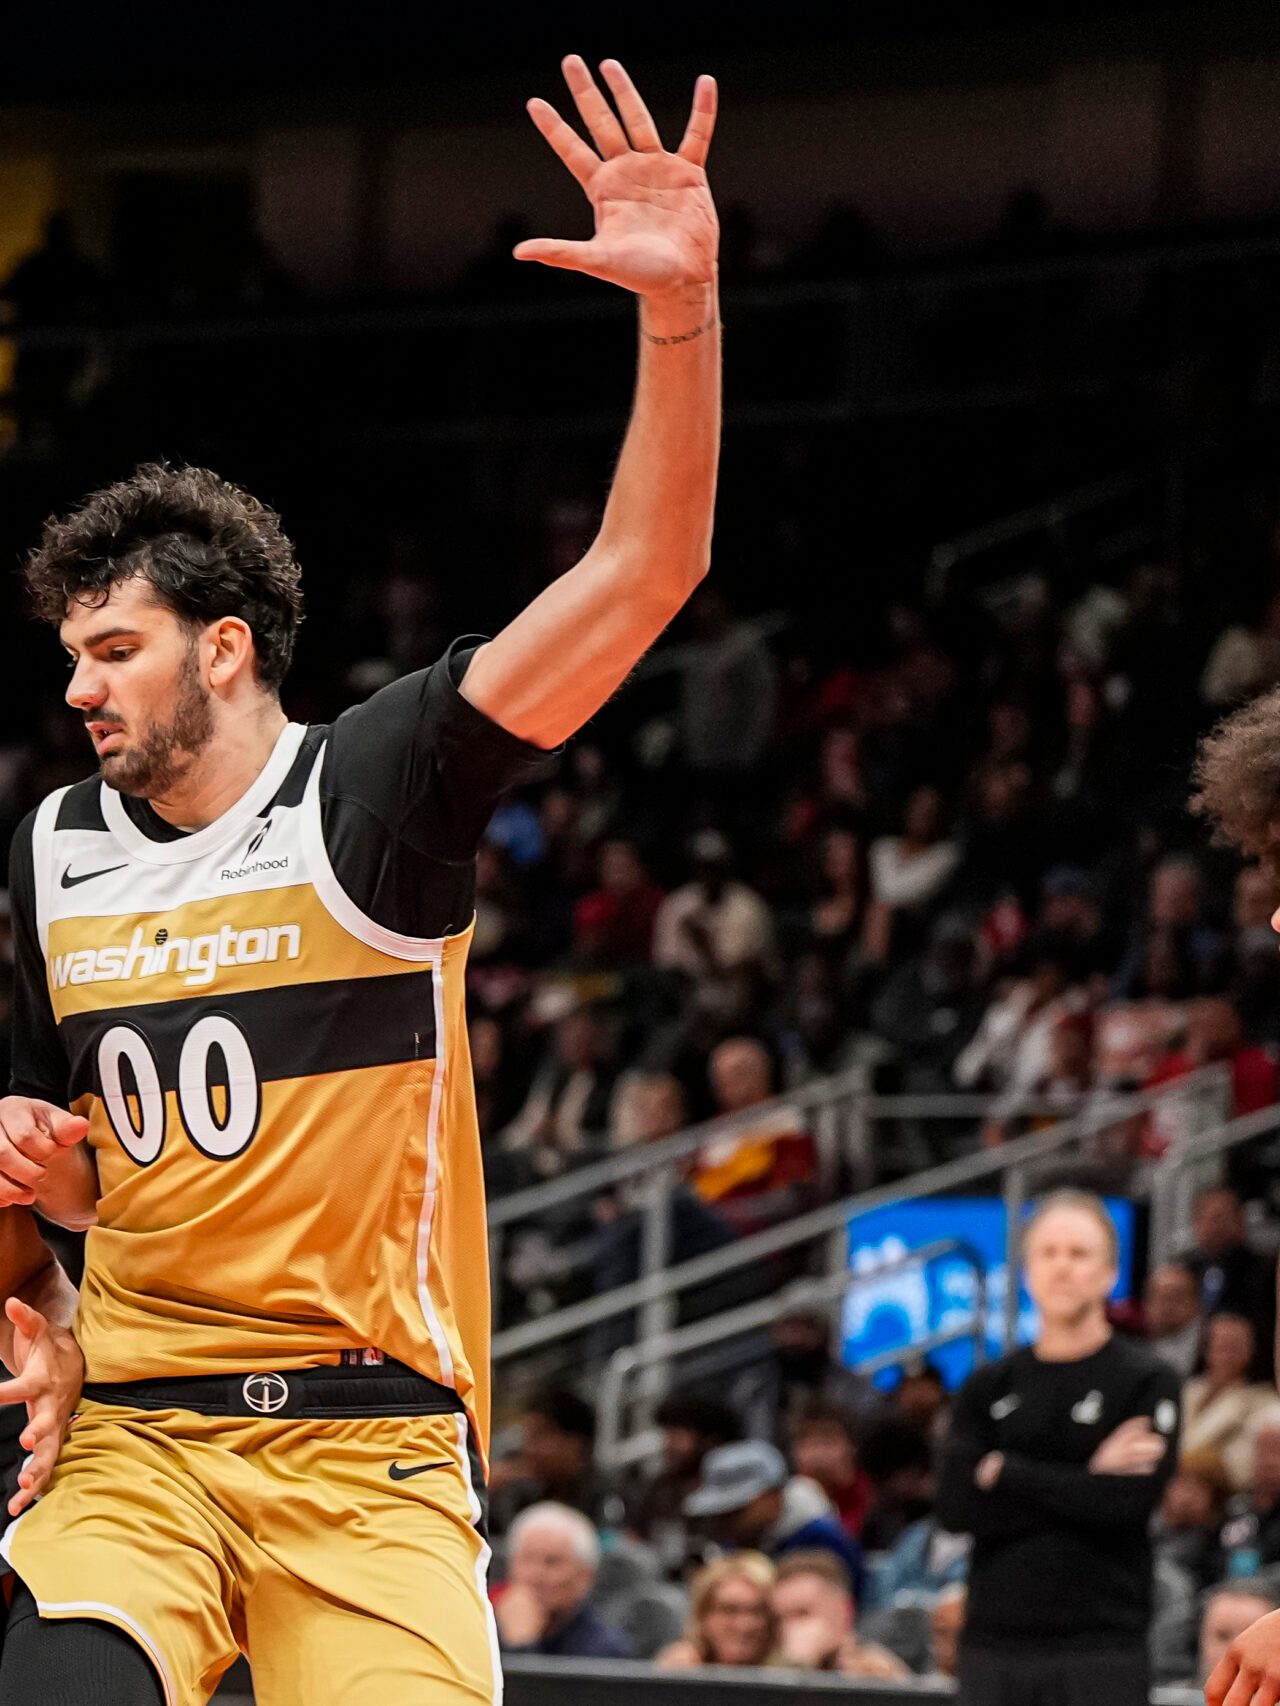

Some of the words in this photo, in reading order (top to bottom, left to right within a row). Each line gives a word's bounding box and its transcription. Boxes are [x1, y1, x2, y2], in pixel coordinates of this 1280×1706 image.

[220, 856, 289, 881] Robinhood
[50, 923, 302, 990] washington
[97, 1010, 263, 1168] 00
